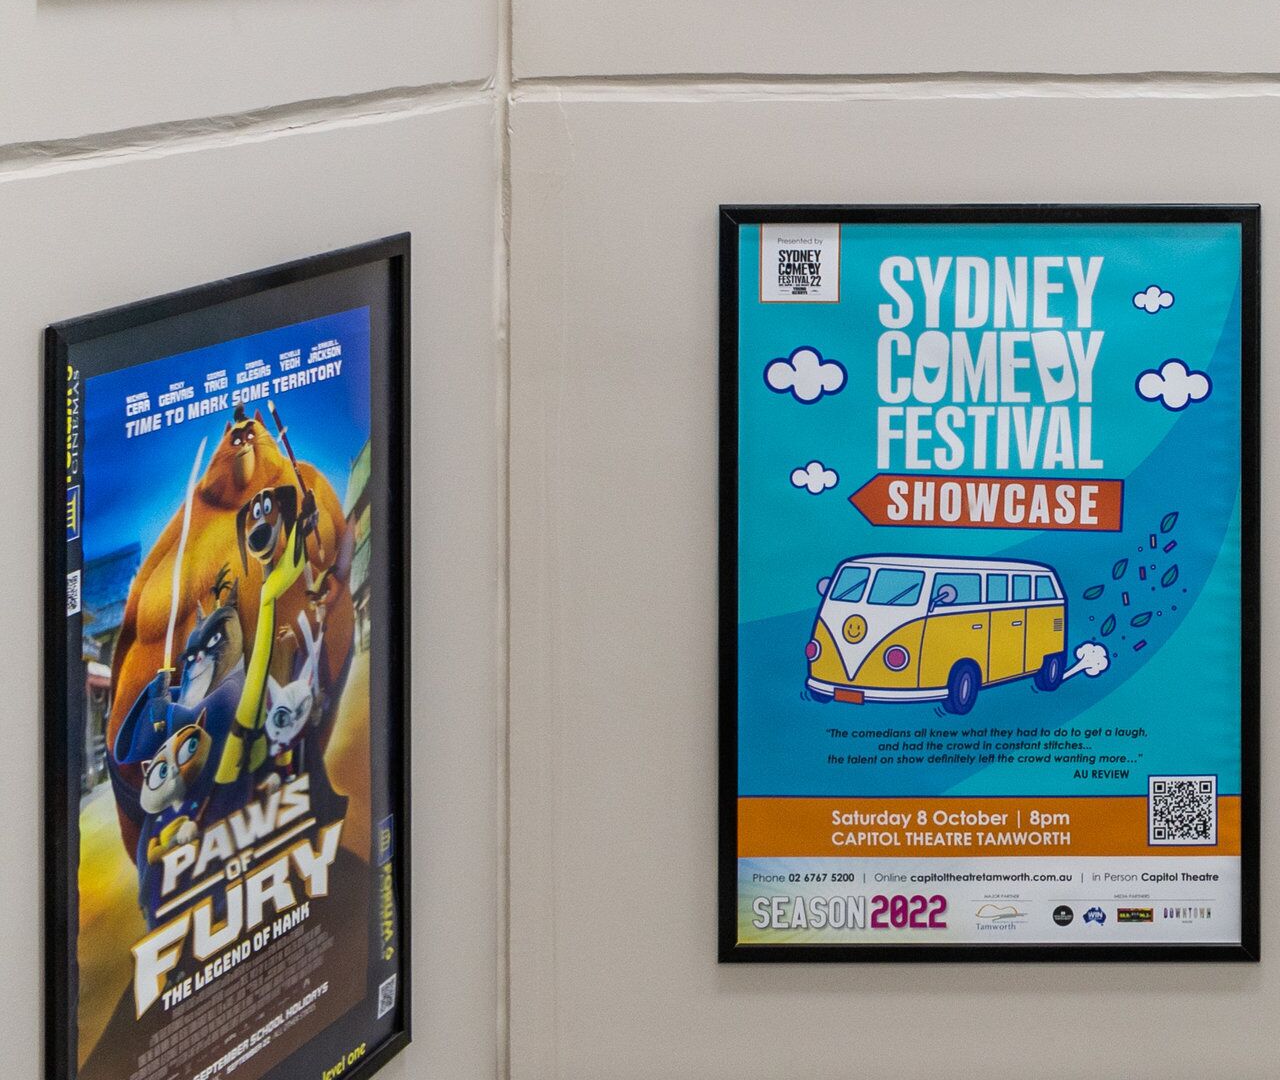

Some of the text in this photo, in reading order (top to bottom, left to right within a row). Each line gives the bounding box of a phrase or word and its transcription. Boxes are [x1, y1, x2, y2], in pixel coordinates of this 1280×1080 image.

[878, 255, 1104, 329] SYDNEY
[877, 329, 1105, 403] COMEDY
[126, 360, 343, 438] TIME TO MARK SOME TERRITORY
[876, 405, 1103, 470] FESTIVAL
[885, 480, 1098, 526] SHOWCASE
[160, 772, 311, 897] PAWS
[831, 809, 1070, 829] Saturday 8 October 8pm
[831, 831, 1070, 846] CAPITOL THEATRE TAMWORTH
[225, 850, 254, 880] OF
[873, 872, 1072, 884] Online capitoltheatretamworth.com.au
[131, 819, 344, 1020] FURY
[752, 894, 947, 929] SEASON 2022
[162, 901, 310, 1010] THE LEGEND OF HANK
